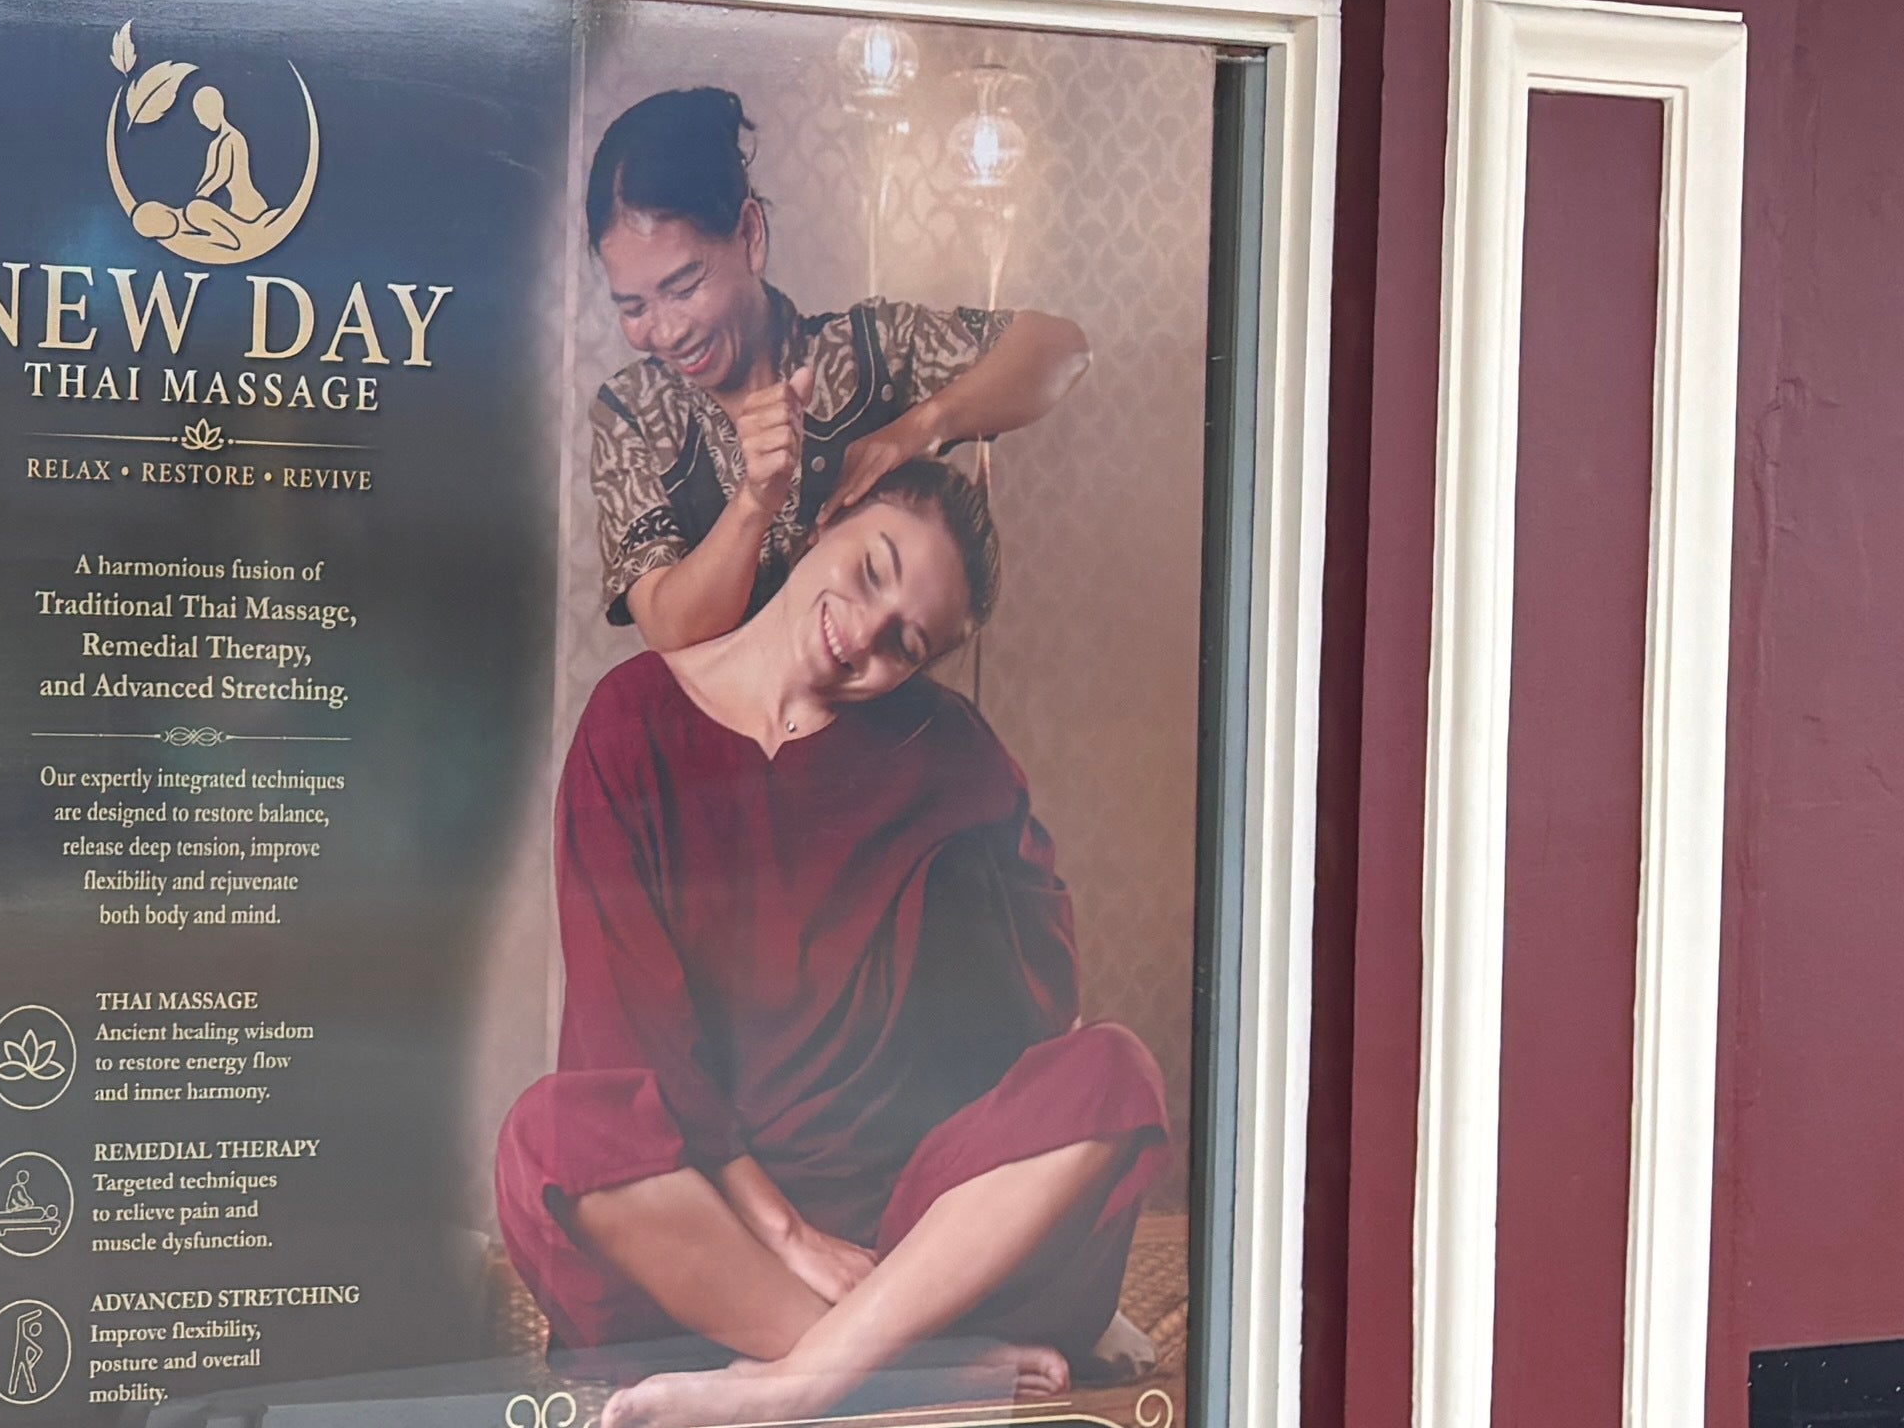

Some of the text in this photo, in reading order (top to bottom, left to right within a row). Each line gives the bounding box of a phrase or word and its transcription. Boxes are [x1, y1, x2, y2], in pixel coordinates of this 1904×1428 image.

[244, 276, 453, 366] DAY
[25, 363, 377, 410] THAI MASSAGE
[28, 459, 371, 489] RELAX RESTORE REVIVE
[75, 555, 324, 580] A harmonious fusion of
[35, 591, 356, 629] Traditional Thai Massage,
[83, 633, 311, 667] Remedial Therapy,
[40, 673, 348, 709] and Advanced Stretching.
[41, 766, 344, 795] Our expertly integrated techniques
[84, 870, 298, 896] flexibility and rejuvenate
[96, 992, 257, 1010] THAI MASSAGE
[95, 1022, 313, 1045] Ancient healing wisdom
[95, 1140, 320, 1161] REMEDIAL THERAPY
[93, 1171, 277, 1196] Targeted techniques
[91, 1286, 359, 1311] ADVANCED STRETCHING
[91, 1320, 260, 1347] Improve flexibility,
